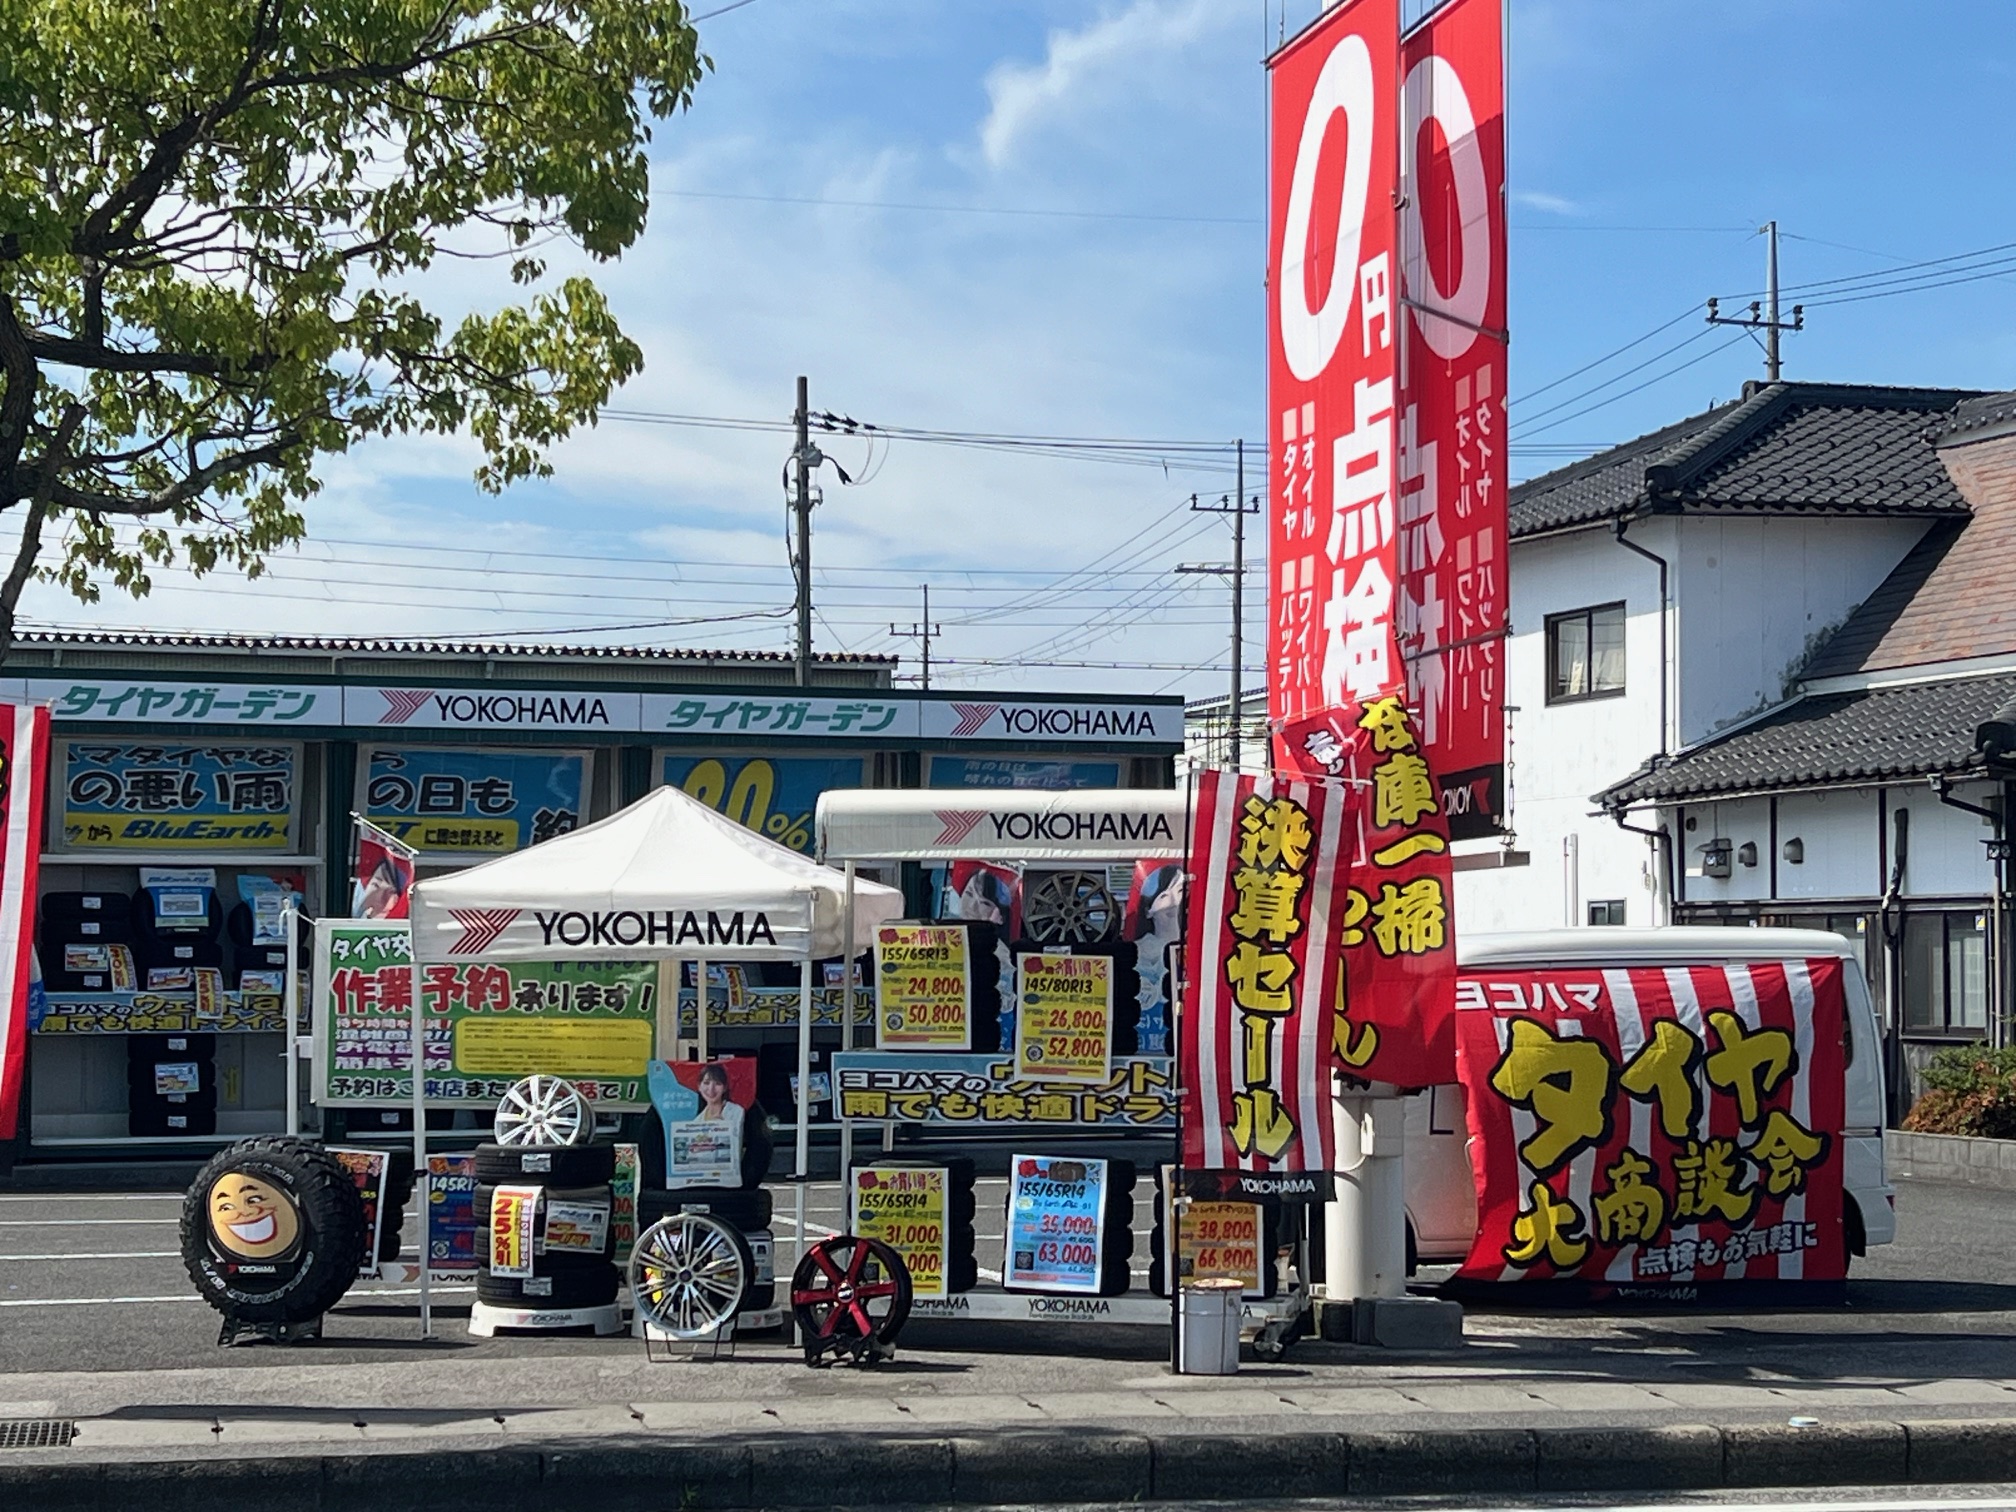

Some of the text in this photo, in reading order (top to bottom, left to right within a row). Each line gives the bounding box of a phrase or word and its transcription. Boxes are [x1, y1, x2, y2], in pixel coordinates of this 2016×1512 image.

[1281, 443, 1298, 542] タイヤ
[1300, 435, 1316, 540] オイル
[1278, 592, 1296, 723] バッテリ
[1296, 589, 1313, 720] ワイパー
[54, 685, 317, 720] タイヤガーデン
[434, 695, 609, 725] YOKOHAMA
[665, 699, 898, 732] タイヤガーデン
[1000, 708, 1156, 736] YOKOHAMA
[70, 770, 292, 811] の悪い雨
[367, 774, 519, 815] の日も
[120, 819, 289, 840] BluEarth-
[990, 812, 1174, 842] YOKOHAMA
[533, 910, 777, 946] YOKOHAMA
[882, 947, 949, 961] 155/65R13
[1025, 978, 1093, 994] 145/80R13
[1226, 794, 1315, 1162] 決算セール
[1454, 980, 1601, 1013] ヨコハマ
[843, 1091, 1176, 1122] 雨でも快適ドラ
[1490, 1009, 1796, 1176] タイヤ
[859, 1193, 928, 1208] 155/65R14
[1018, 1181, 1086, 1199] 155/65R14
[1239, 1177, 1316, 1193] YOKOHAMA
[1638, 1222, 1819, 1276] 点検もお気軽に
[1028, 1298, 1111, 1314] YOKOHAMA
